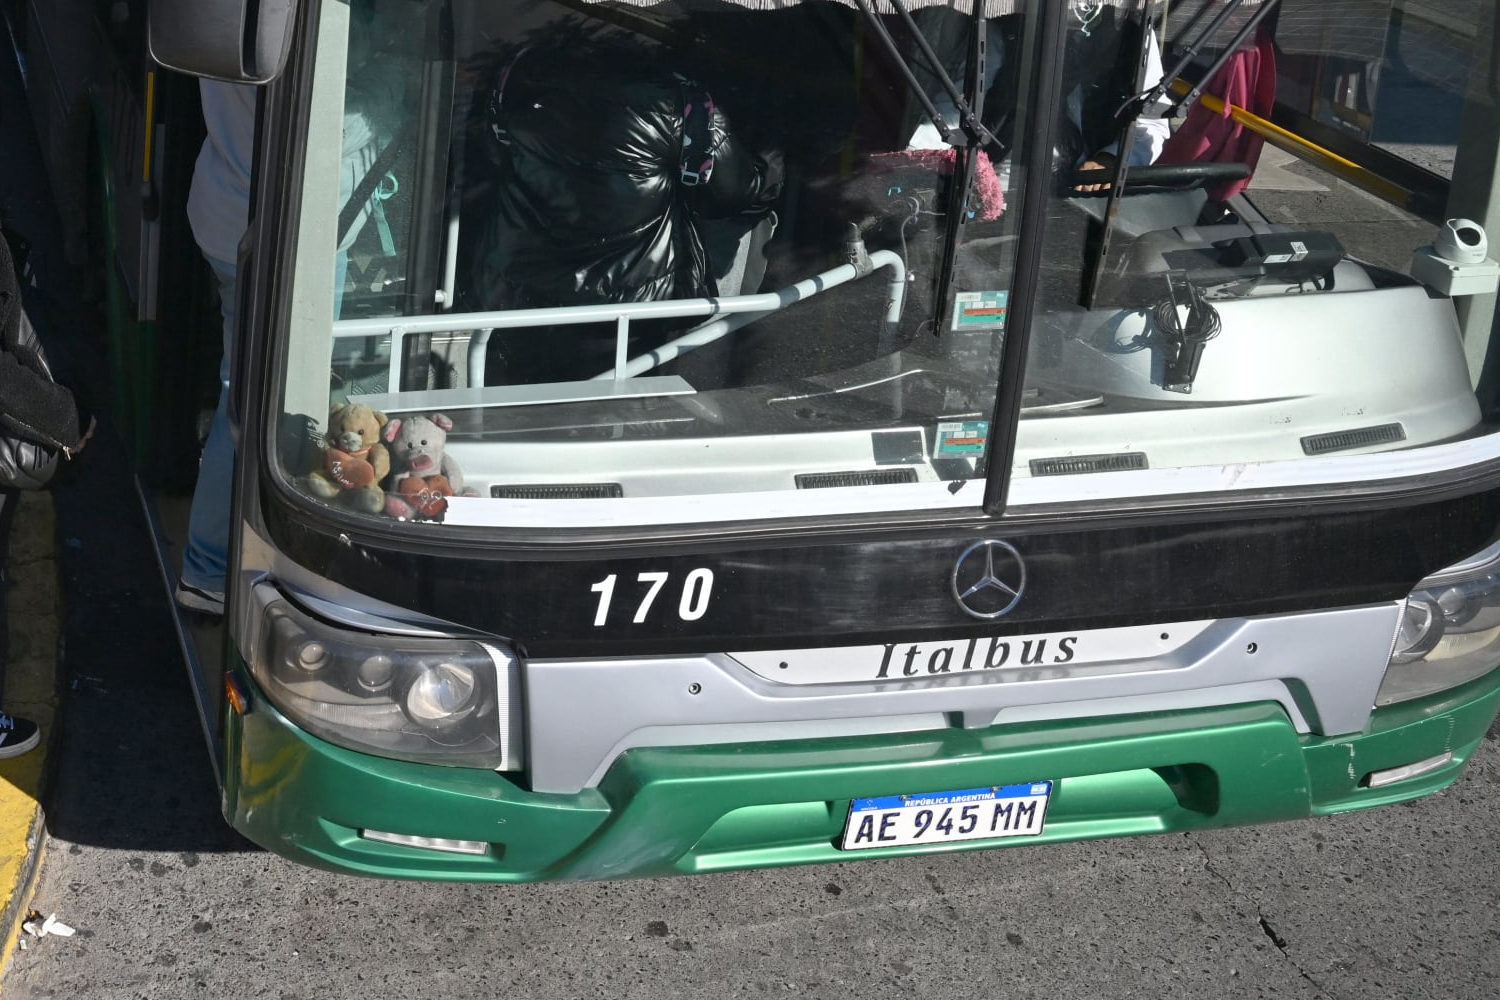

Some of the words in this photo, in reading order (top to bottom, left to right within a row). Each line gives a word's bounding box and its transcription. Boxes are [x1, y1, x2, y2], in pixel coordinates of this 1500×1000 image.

[590, 567, 714, 627] 170
[875, 636, 1078, 679] Italbus
[854, 811, 901, 844] AE
[913, 804, 980, 839] 945
[990, 799, 1038, 832] MM
[904, 796, 949, 808] REPÚBLICA
[950, 792, 996, 804] ARGENTINA
